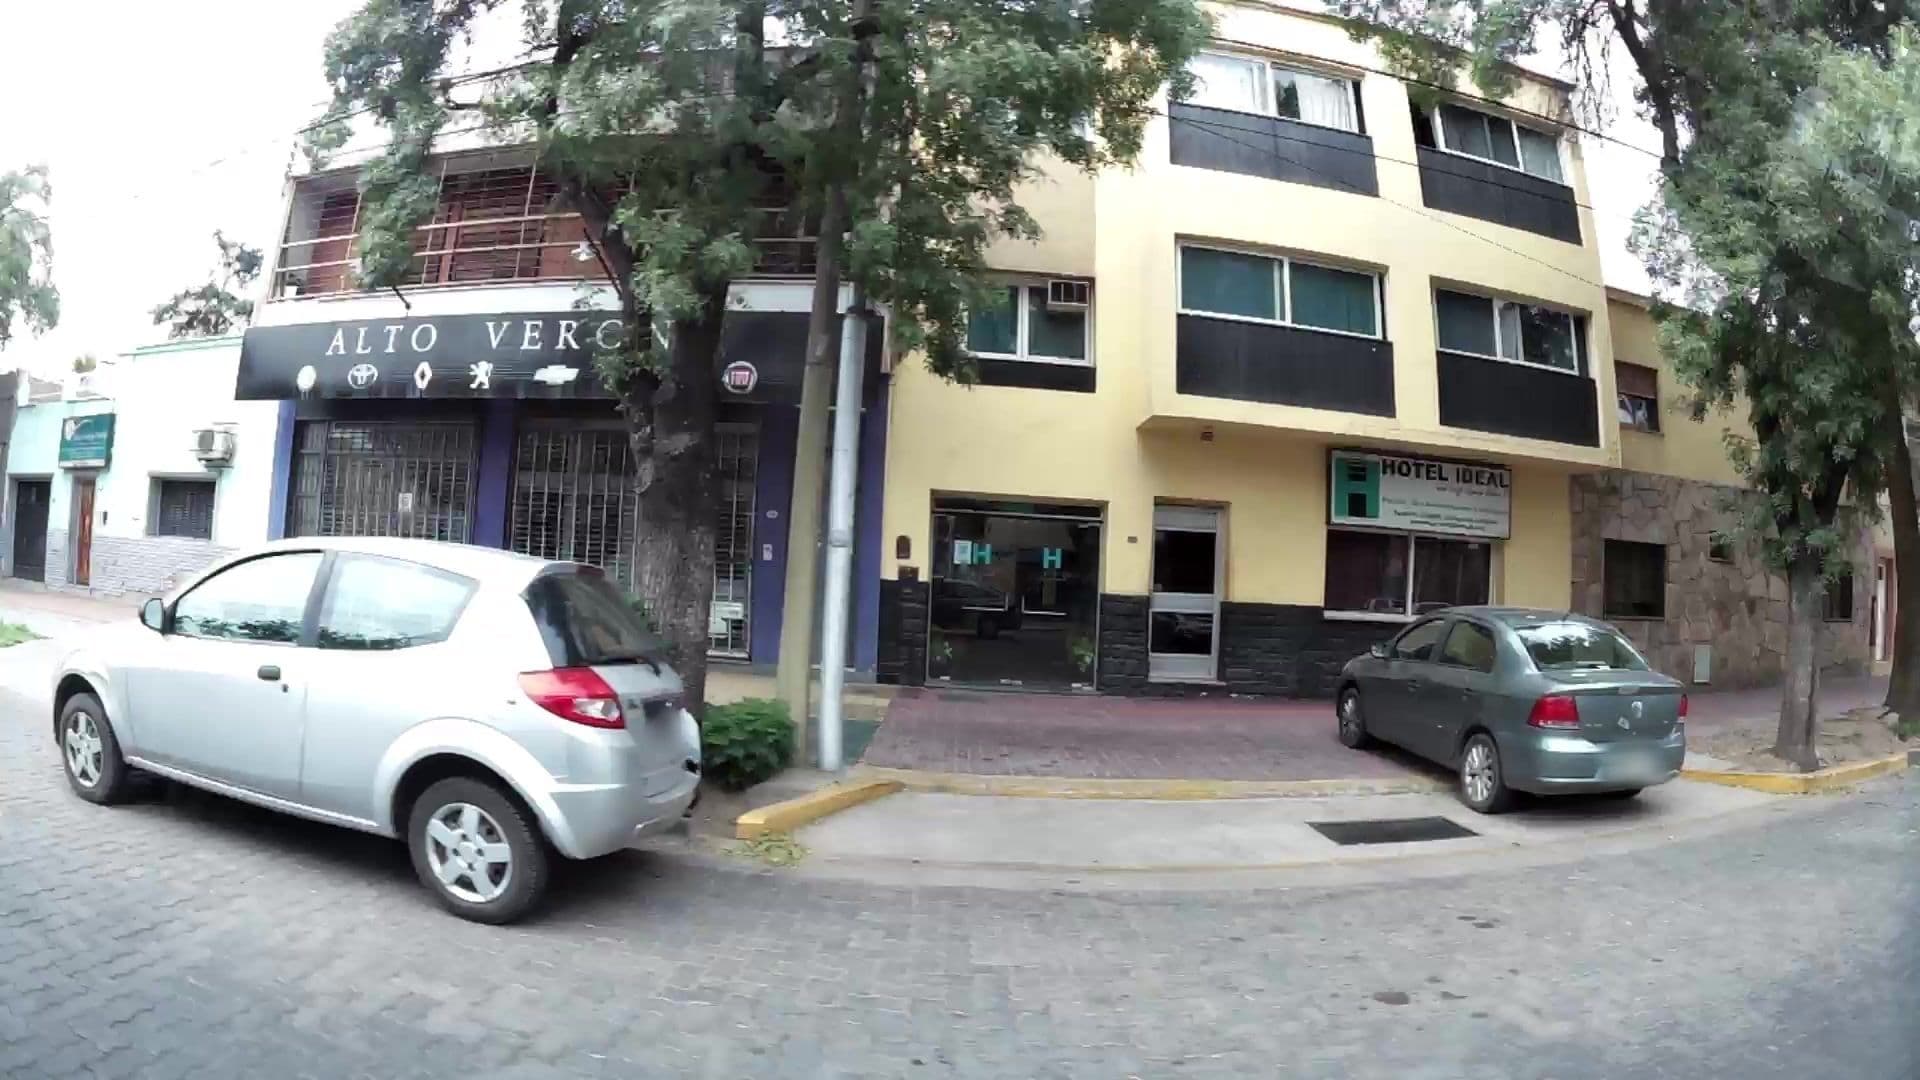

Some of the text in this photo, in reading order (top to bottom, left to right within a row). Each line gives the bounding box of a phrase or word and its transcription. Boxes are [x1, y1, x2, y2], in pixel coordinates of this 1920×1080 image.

[325, 323, 438, 356] ALTO
[1381, 459, 1509, 489] HOTEL IDEAL
[973, 542, 992, 565] H
[1042, 547, 1062, 569] H
